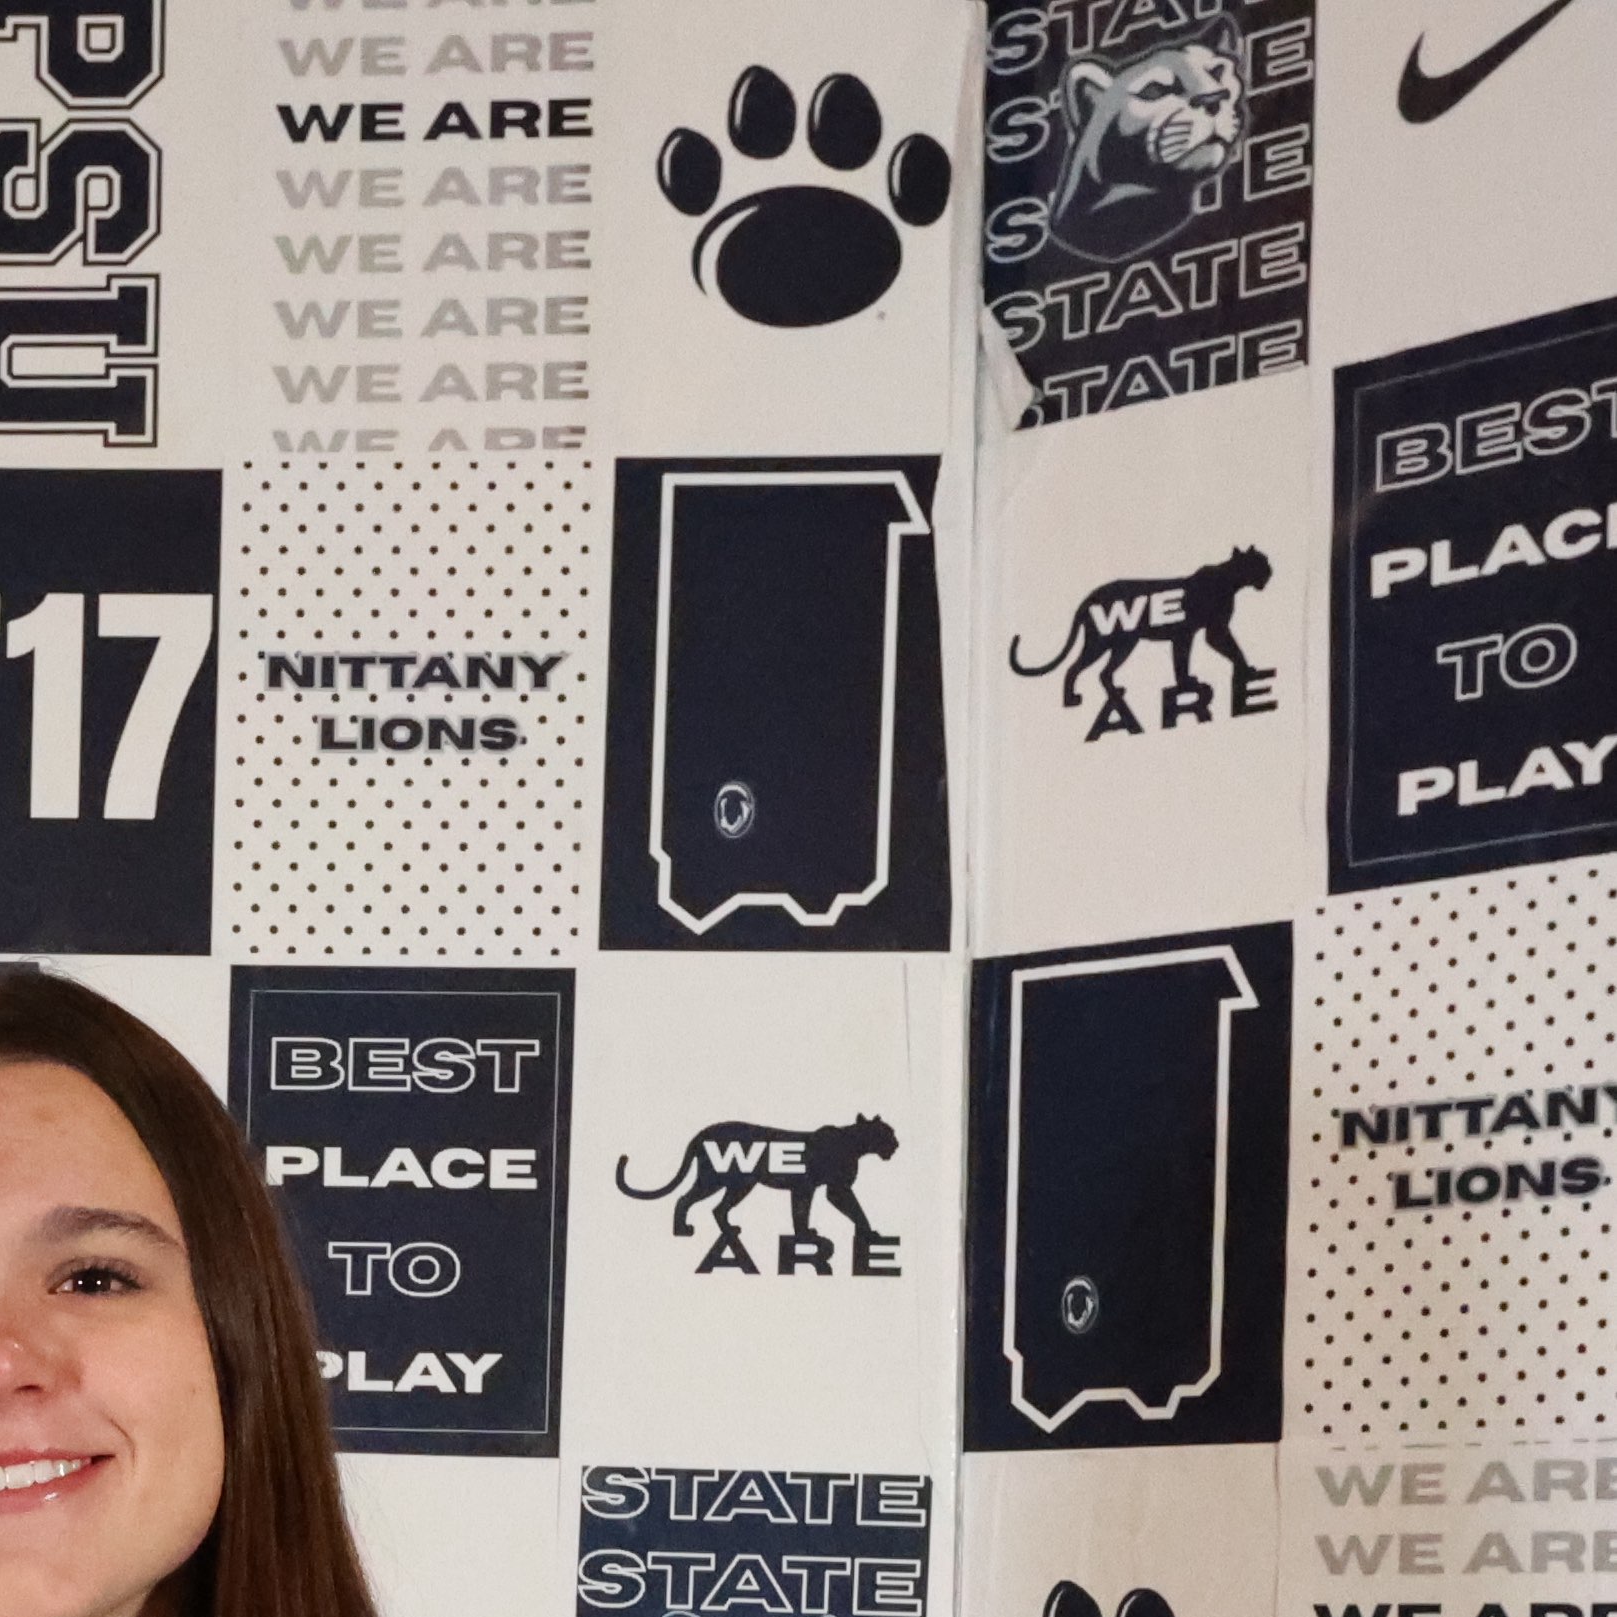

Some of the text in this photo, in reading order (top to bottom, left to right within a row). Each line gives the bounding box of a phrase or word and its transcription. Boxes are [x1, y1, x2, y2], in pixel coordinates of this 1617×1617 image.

[277, 31, 594, 76] WE ARE
[276, 98, 593, 143] WE ARE
[275, 164, 593, 208] WE ARE
[274, 230, 592, 274] WE ARE
[988, 222, 1307, 353] STATE
[273, 295, 592, 340] WE ARE
[272, 361, 590, 403] WE ARE
[1022, 319, 1304, 429] TATE
[1371, 503, 1617, 599] PLAC
[1087, 588, 1186, 635] WE
[266, 653, 566, 691] NITTANY
[1437, 623, 1578, 701] TO
[1084, 668, 1279, 743] ARE
[318, 716, 522, 753] LIONS
[1398, 734, 1617, 816] PLAY
[270, 1036, 540, 1094] BEST
[266, 1146, 538, 1190] PLACE
[702, 1140, 806, 1174] WE
[1394, 1157, 1602, 1209] LIONS
[328, 1241, 461, 1297] TO
[694, 1234, 902, 1277] ARE
[583, 1465, 926, 1527] STATE
[1315, 1463, 1447, 1506] WE
[1314, 1533, 1445, 1575] WE
[577, 1548, 922, 1617] STATE
